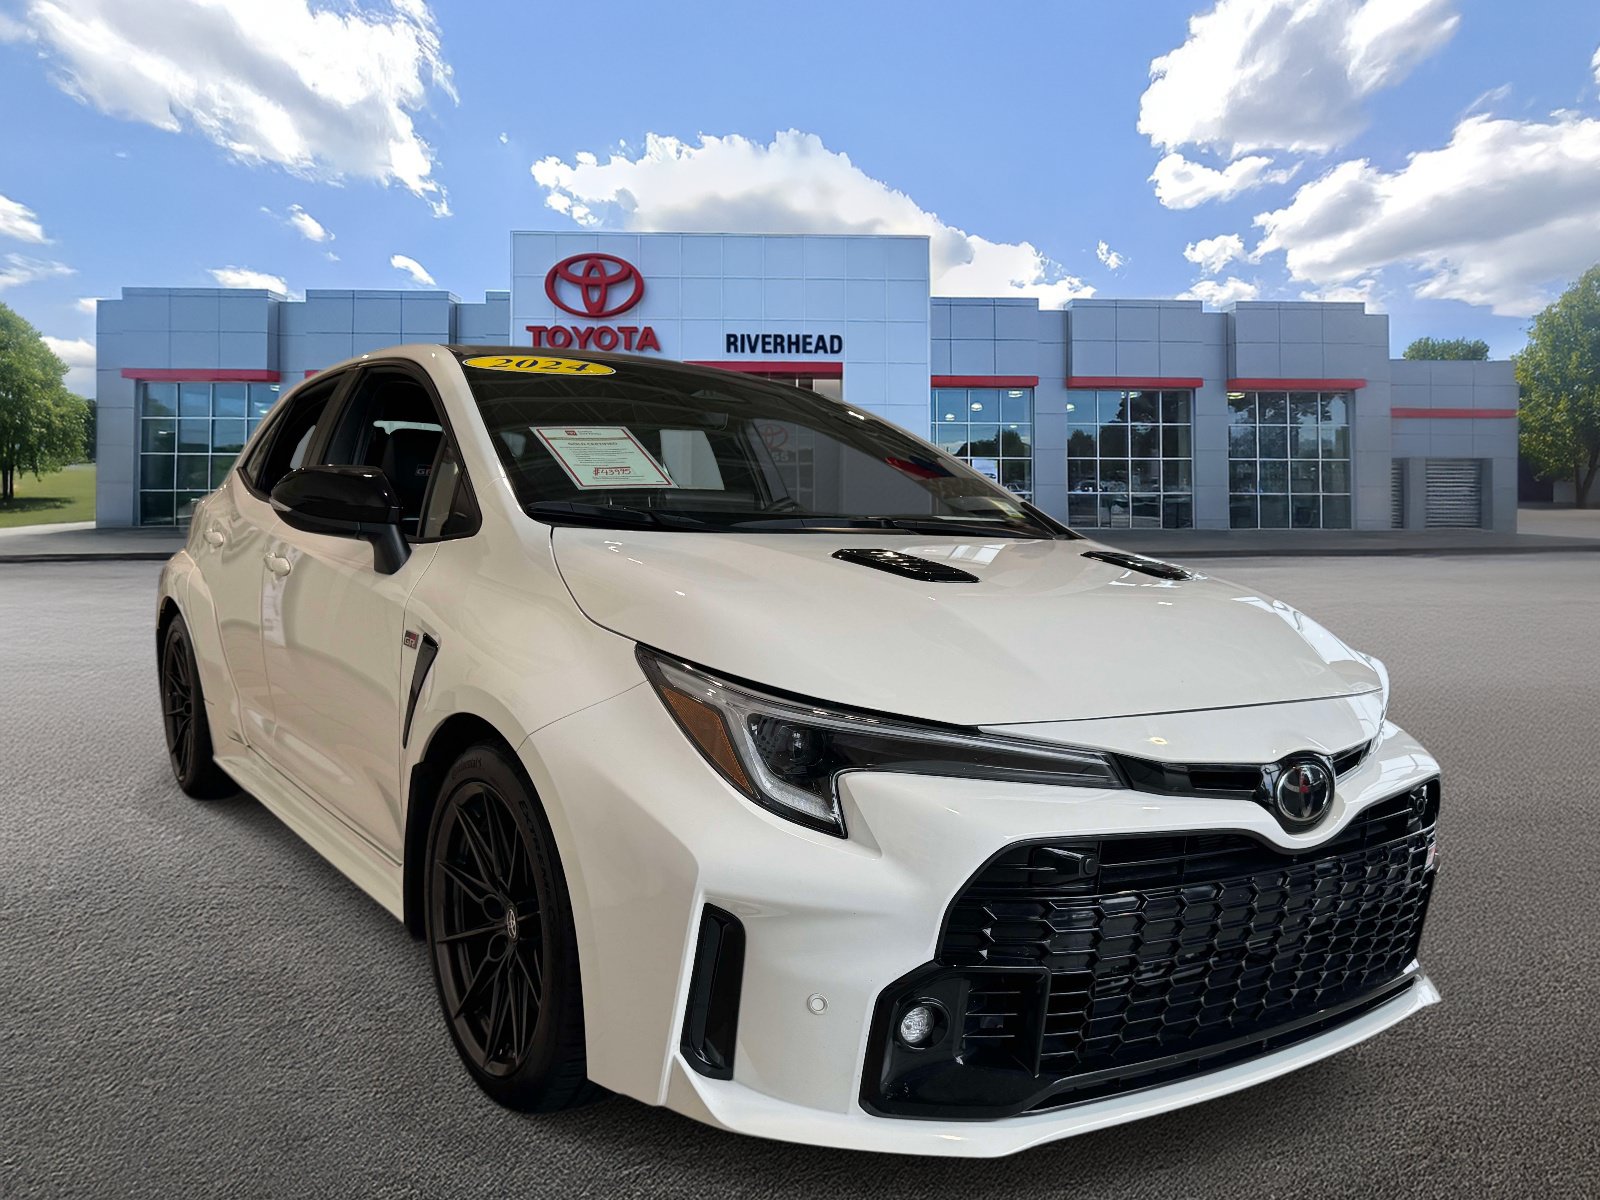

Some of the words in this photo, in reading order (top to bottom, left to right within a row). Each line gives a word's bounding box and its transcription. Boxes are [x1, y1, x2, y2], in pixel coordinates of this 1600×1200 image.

[526, 325, 661, 352] TOYOTA
[726, 333, 843, 354] RIVERHEAD
[488, 358, 590, 372] 2024
[404, 636, 416, 647] GR
